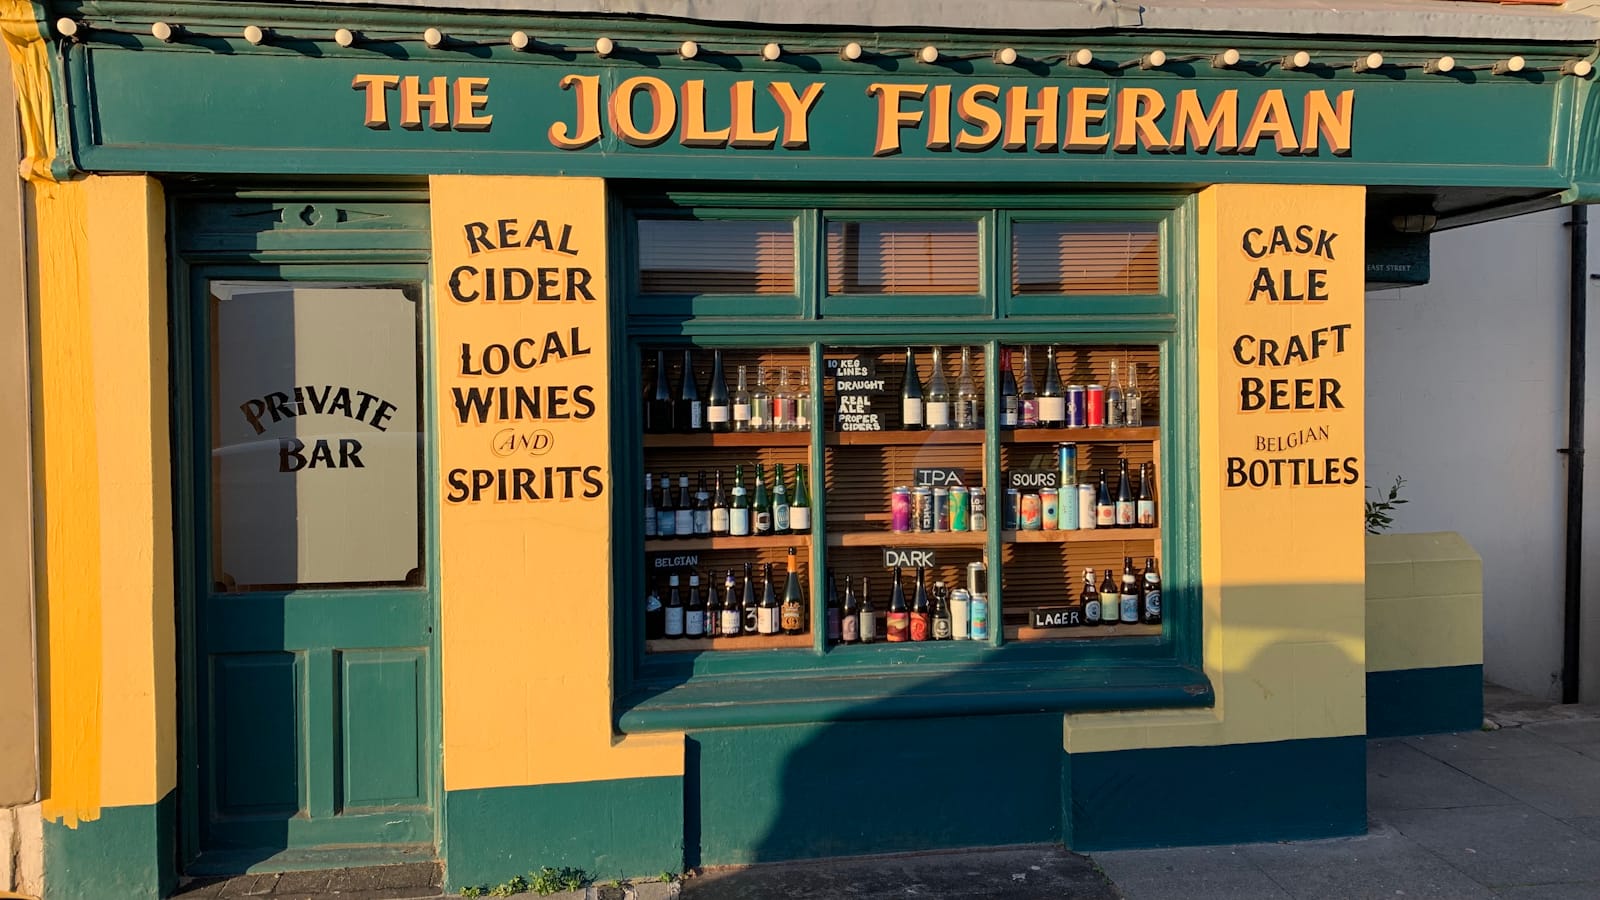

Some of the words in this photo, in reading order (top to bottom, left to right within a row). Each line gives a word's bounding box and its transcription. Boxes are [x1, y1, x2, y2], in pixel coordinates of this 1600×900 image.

[351, 73, 494, 131] THE
[548, 74, 826, 150] JOLLY
[865, 82, 1355, 157] FISHERMAN
[464, 218, 579, 256] REAL
[1242, 224, 1339, 260] CASK
[449, 265, 596, 303] CIDER
[1249, 267, 1329, 301] ALE
[461, 326, 591, 376] LOCAL
[1233, 323, 1352, 367] CRAFT
[836, 366, 868, 377] LINES
[841, 359, 860, 368] KEG
[837, 380, 885, 391] DRAUGHT
[1240, 377, 1345, 411] BEER
[240, 385, 398, 436] PRIVATE
[452, 385, 596, 424] WINES
[838, 404, 865, 413] ALE
[840, 395, 871, 405] REAL
[838, 414, 879, 423] PROPER
[842, 422, 881, 431] CIDERS
[491, 428, 554, 457] AND
[1255, 425, 1329, 452] BELGIAN
[279, 438, 366, 473] BAR
[447, 465, 604, 503] SPIRITS
[919, 470, 963, 486] IPA
[1012, 473, 1057, 487] SOURS
[1227, 456, 1359, 488] BOTTLES
[655, 555, 698, 568] BELGIAN
[886, 551, 934, 568] DARK
[744, 607, 758, 632] 3
[1036, 611, 1080, 626] LAGER
